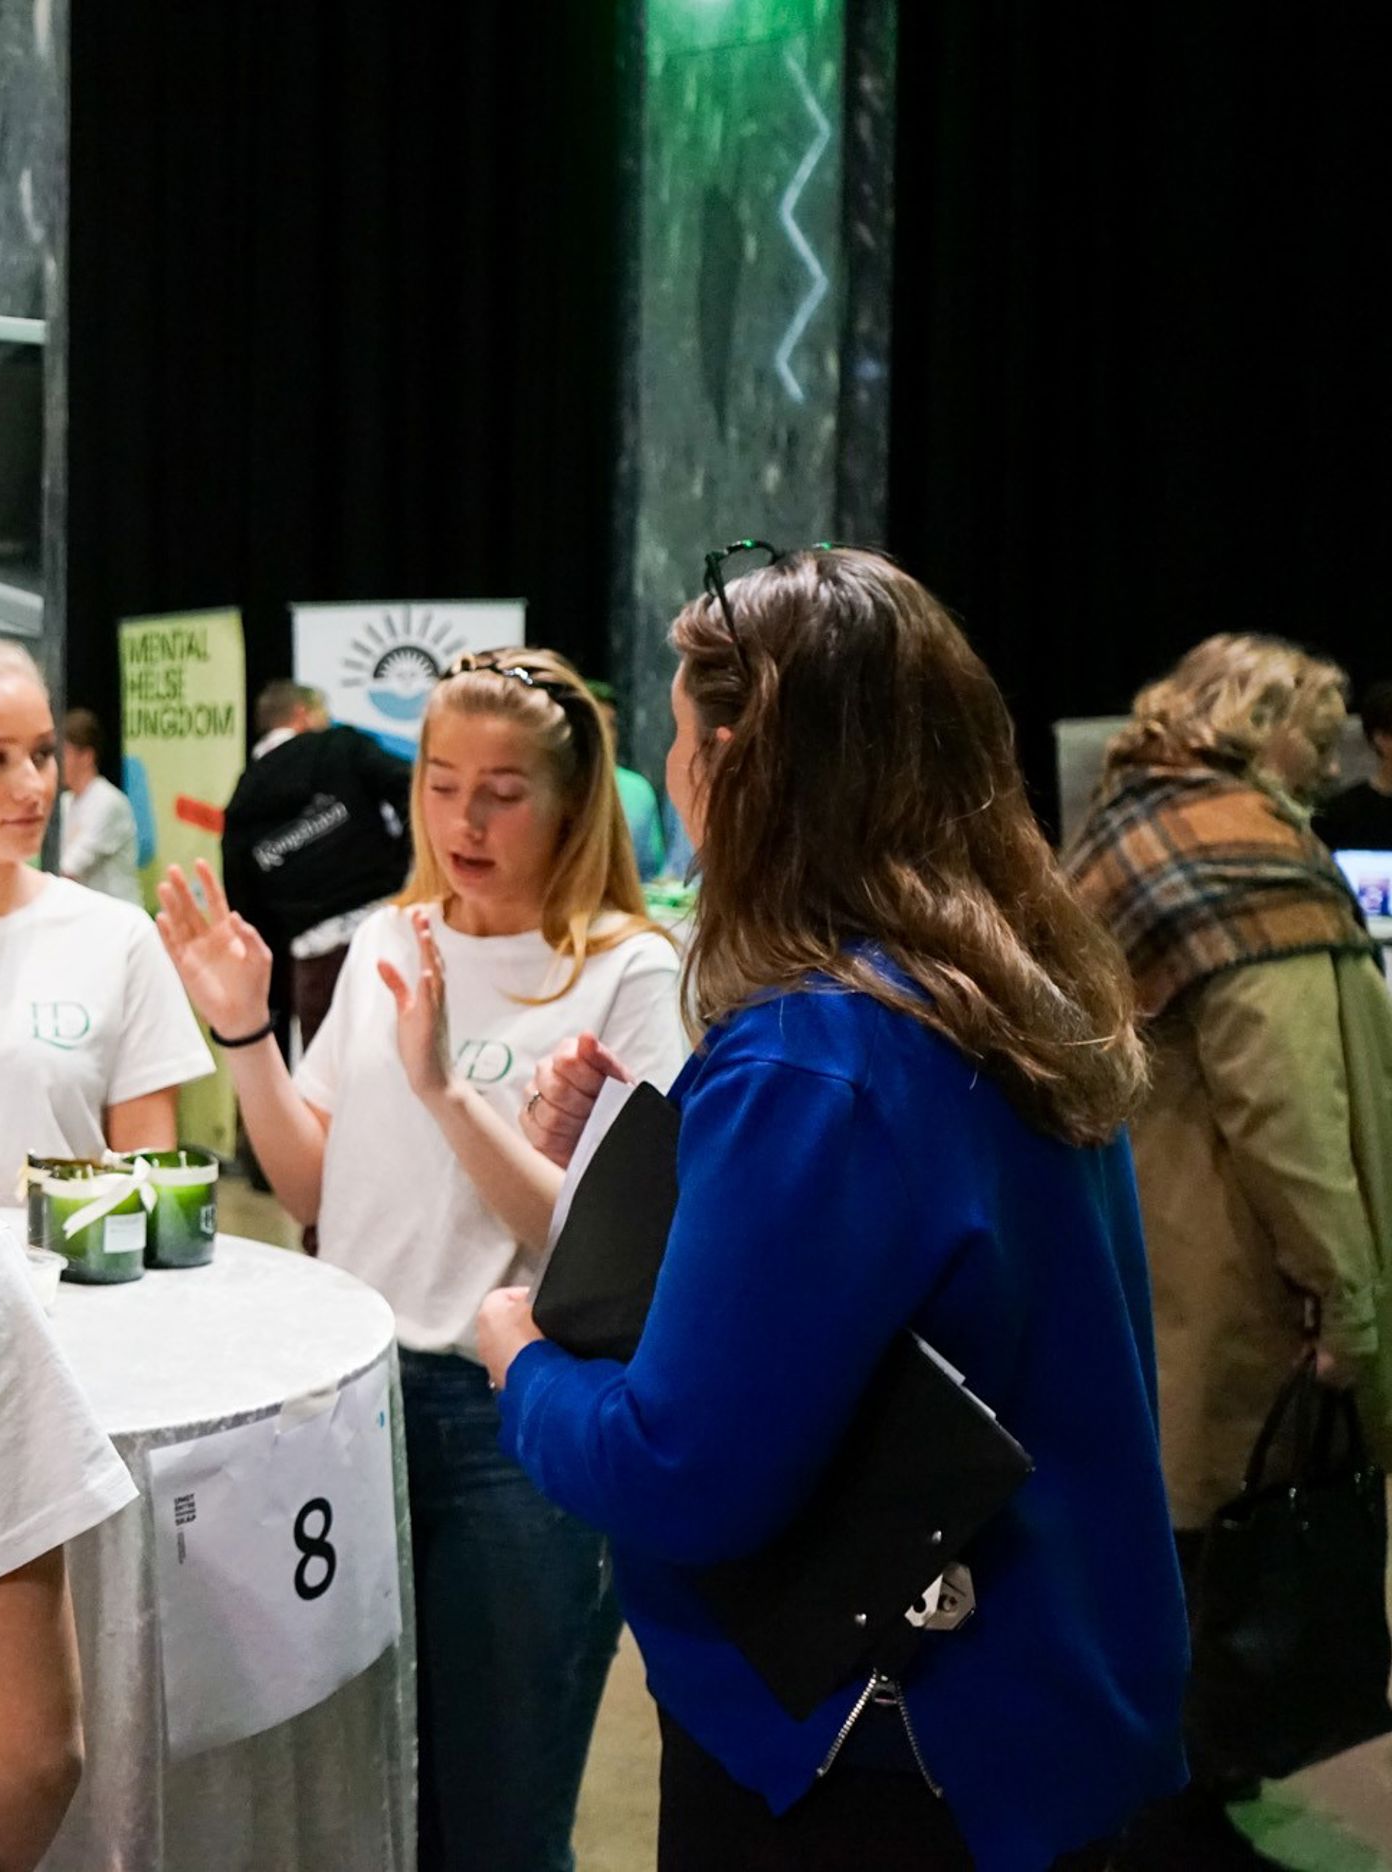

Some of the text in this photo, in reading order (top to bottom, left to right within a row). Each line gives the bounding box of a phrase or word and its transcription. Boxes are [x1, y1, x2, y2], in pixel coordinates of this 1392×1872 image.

[126, 630, 211, 664] MENTAL
[126, 667, 185, 702] HELSE
[126, 702, 235, 738] UNGDOM
[293, 1497, 337, 1601] 8
